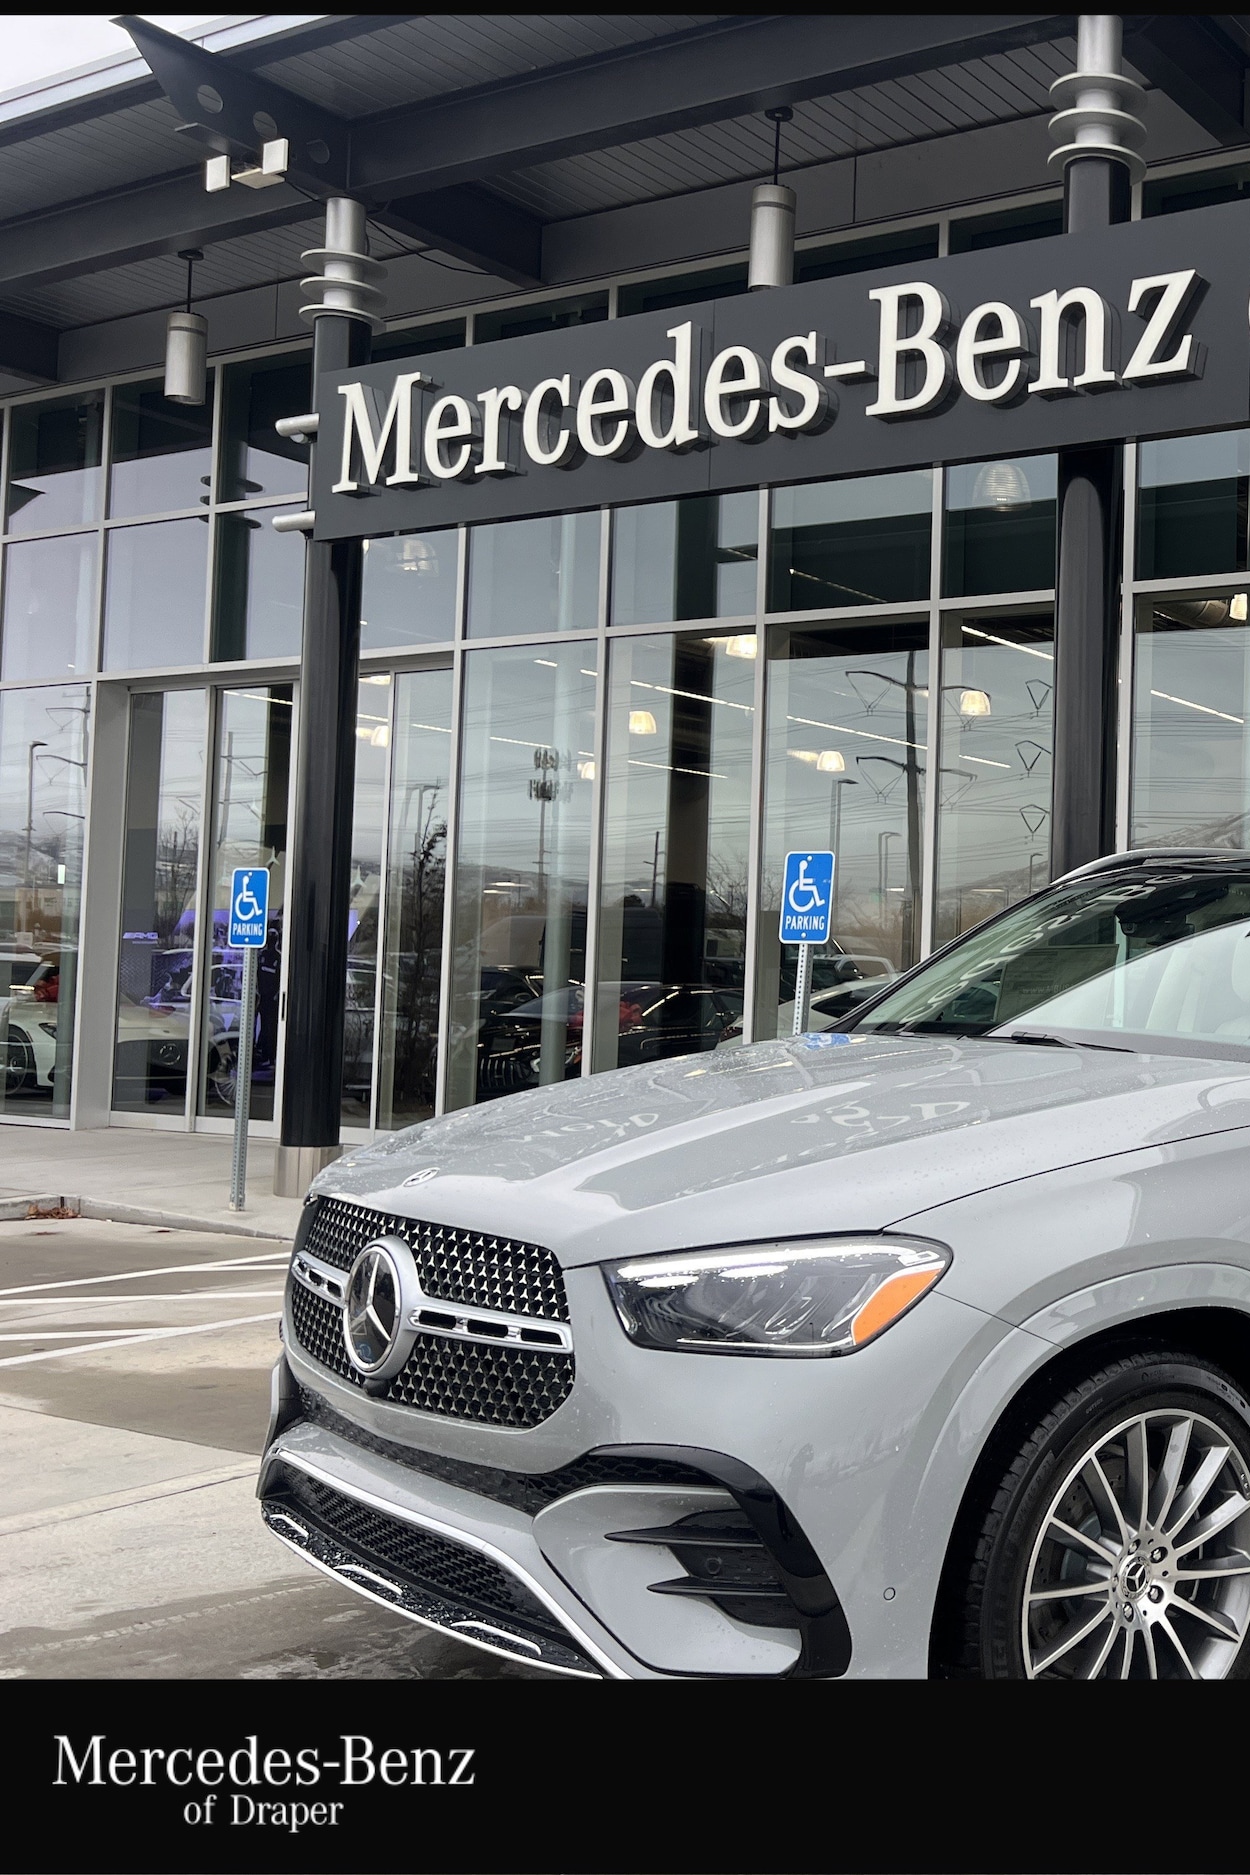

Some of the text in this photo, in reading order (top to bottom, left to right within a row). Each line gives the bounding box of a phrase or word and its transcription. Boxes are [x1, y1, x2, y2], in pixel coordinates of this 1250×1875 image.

[332, 268, 1197, 494] Mercedes-Benz
[232, 923, 263, 937] PARKING
[784, 915, 825, 931] PARKING
